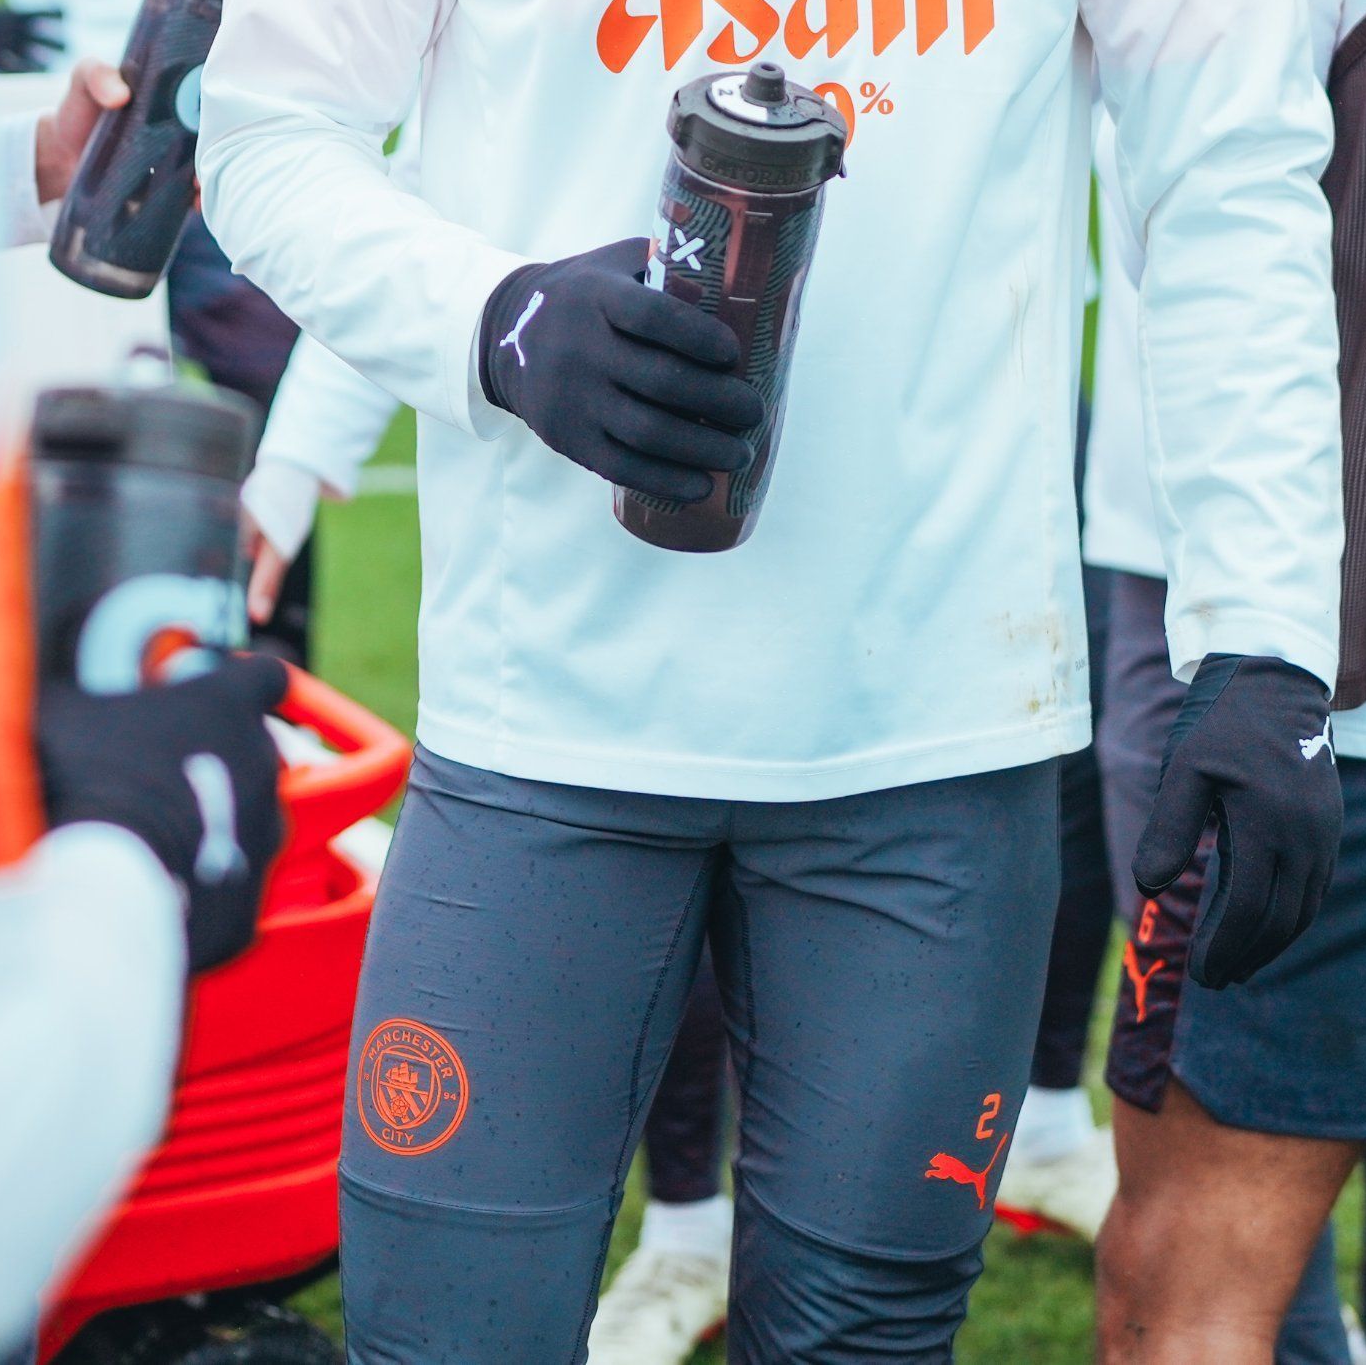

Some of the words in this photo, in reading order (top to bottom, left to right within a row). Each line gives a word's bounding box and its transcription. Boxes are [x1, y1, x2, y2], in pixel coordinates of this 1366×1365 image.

[1137, 899, 1161, 945] 6
[368, 1030, 454, 1079] MANCHESTER
[381, 1127, 414, 1145] CITY
[976, 1093, 1001, 1140] 2
